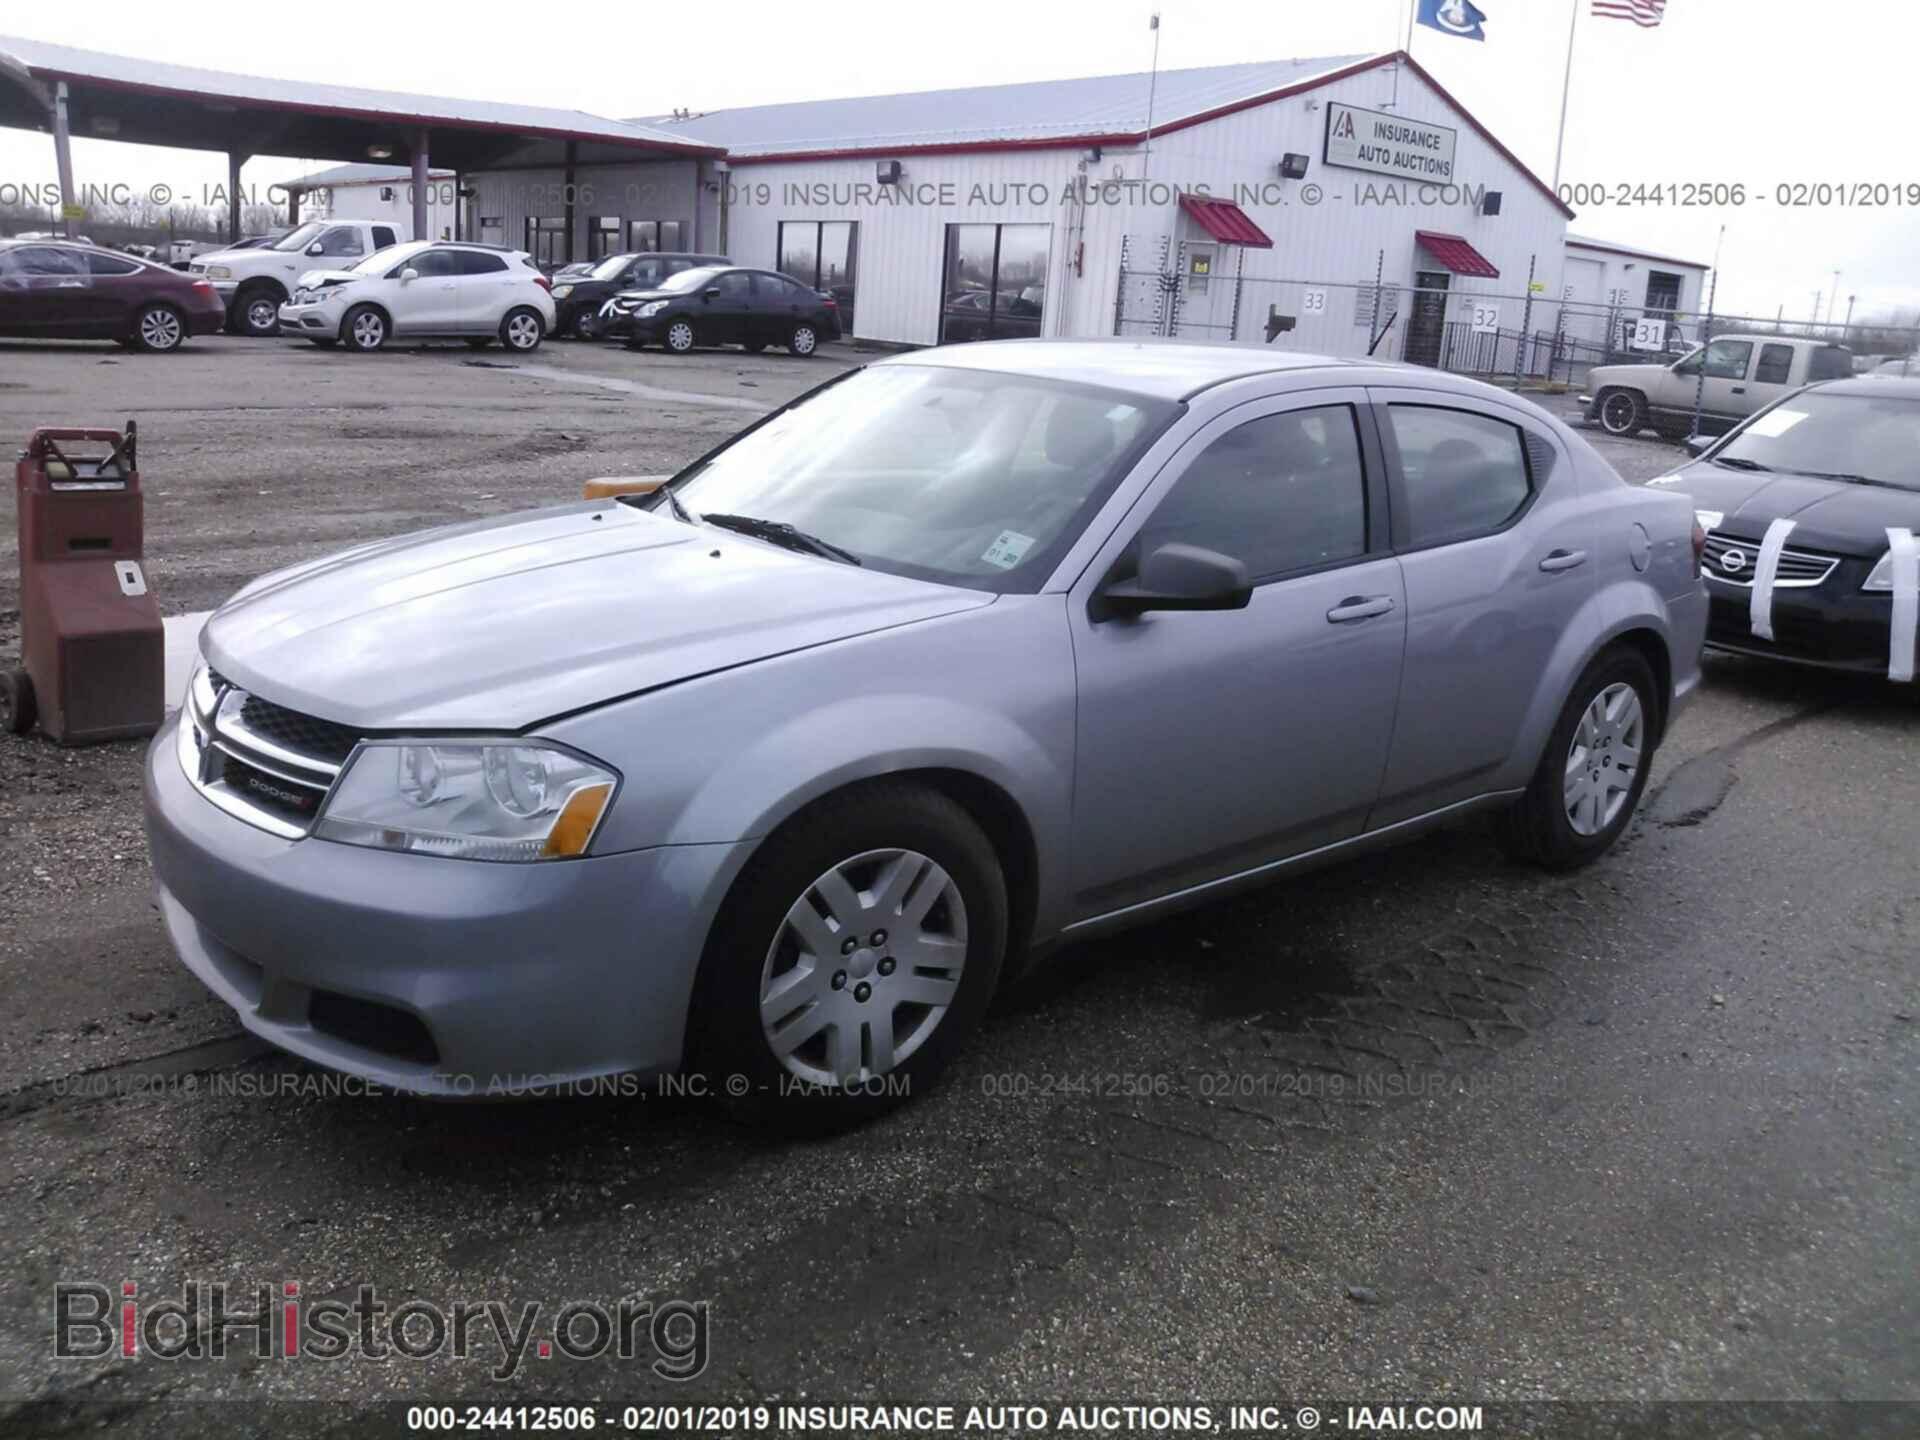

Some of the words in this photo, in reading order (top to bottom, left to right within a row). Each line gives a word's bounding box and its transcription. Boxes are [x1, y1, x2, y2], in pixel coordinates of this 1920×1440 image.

[1373, 121, 1441, 150] INSURANCE
[1358, 143, 1390, 165] AUTO
[1393, 151, 1450, 176] AUCTIONS
[1304, 291, 1324, 310] 33
[1474, 308, 1498, 328] 32
[1637, 325, 1661, 345] 31
